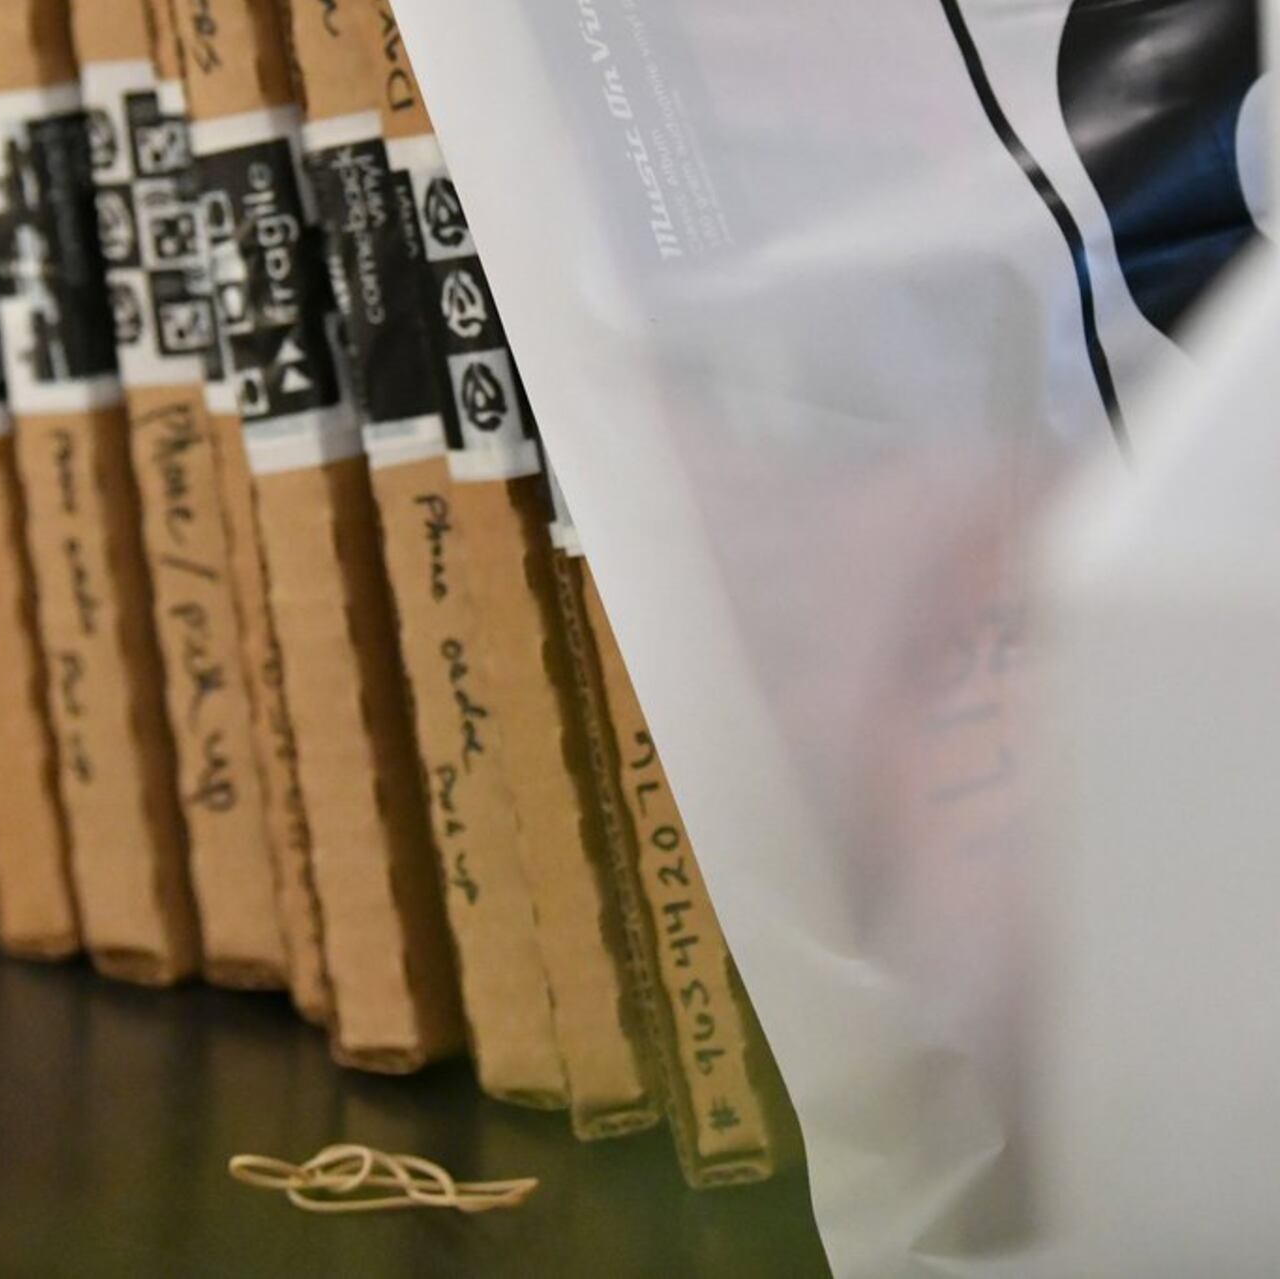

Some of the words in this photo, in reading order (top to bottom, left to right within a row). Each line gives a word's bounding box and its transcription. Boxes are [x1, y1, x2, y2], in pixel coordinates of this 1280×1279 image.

[602, 64, 634, 120] On
[242, 162, 300, 322] fragile
[330, 147, 387, 325] comeback
[354, 154, 388, 229] vinyl
[625, 124, 682, 260] Music
[183, 731, 238, 813] up
